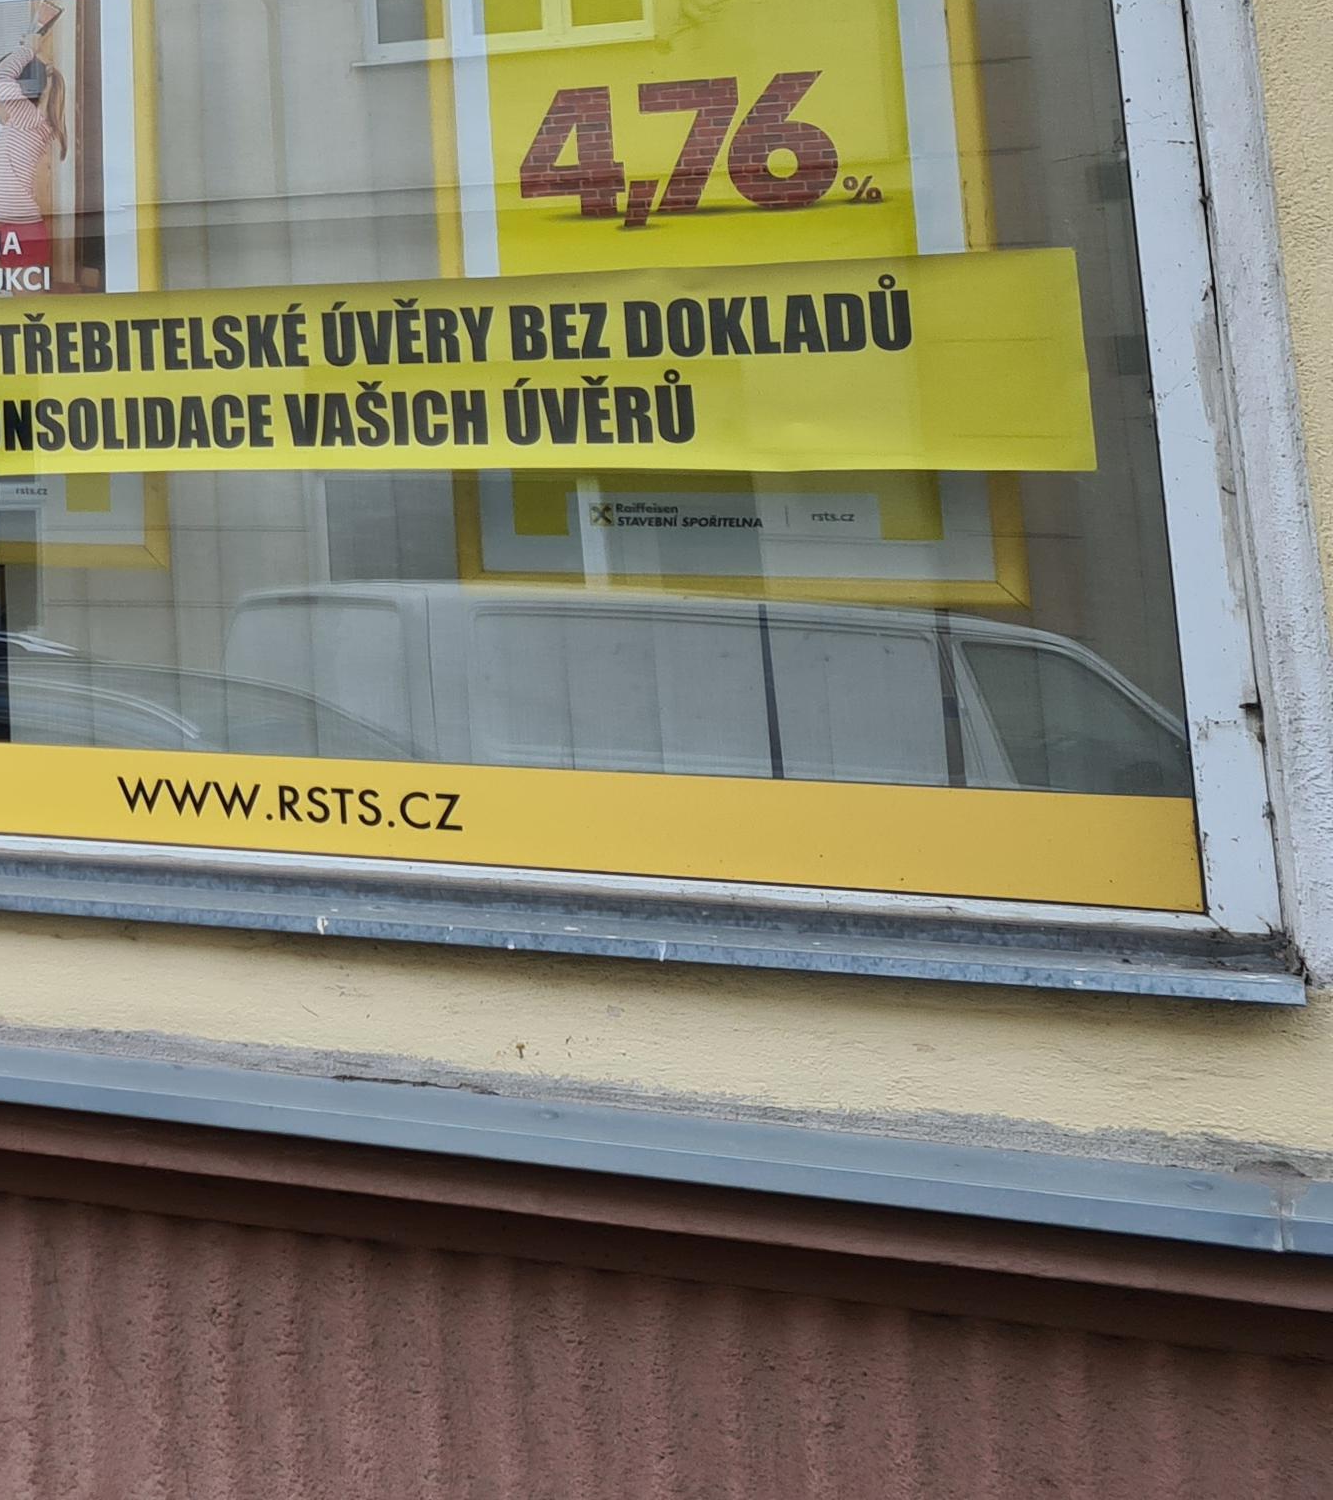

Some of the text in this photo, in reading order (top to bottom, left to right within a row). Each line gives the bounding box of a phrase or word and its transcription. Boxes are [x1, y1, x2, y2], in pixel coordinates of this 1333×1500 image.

[322, 298, 493, 367] ÚVĚRY
[509, 301, 609, 361] BEZ
[624, 274, 913, 359] DOKLADŮ
[284, 381, 488, 448] VAŠICH
[504, 369, 696, 446] ÚVĚRŮ
[615, 503, 679, 514] Raiffeisen
[617, 515, 763, 528] STAVEBNÍ SPOŘITELNA
[117, 775, 464, 832] WWW.RSTS.CZ
